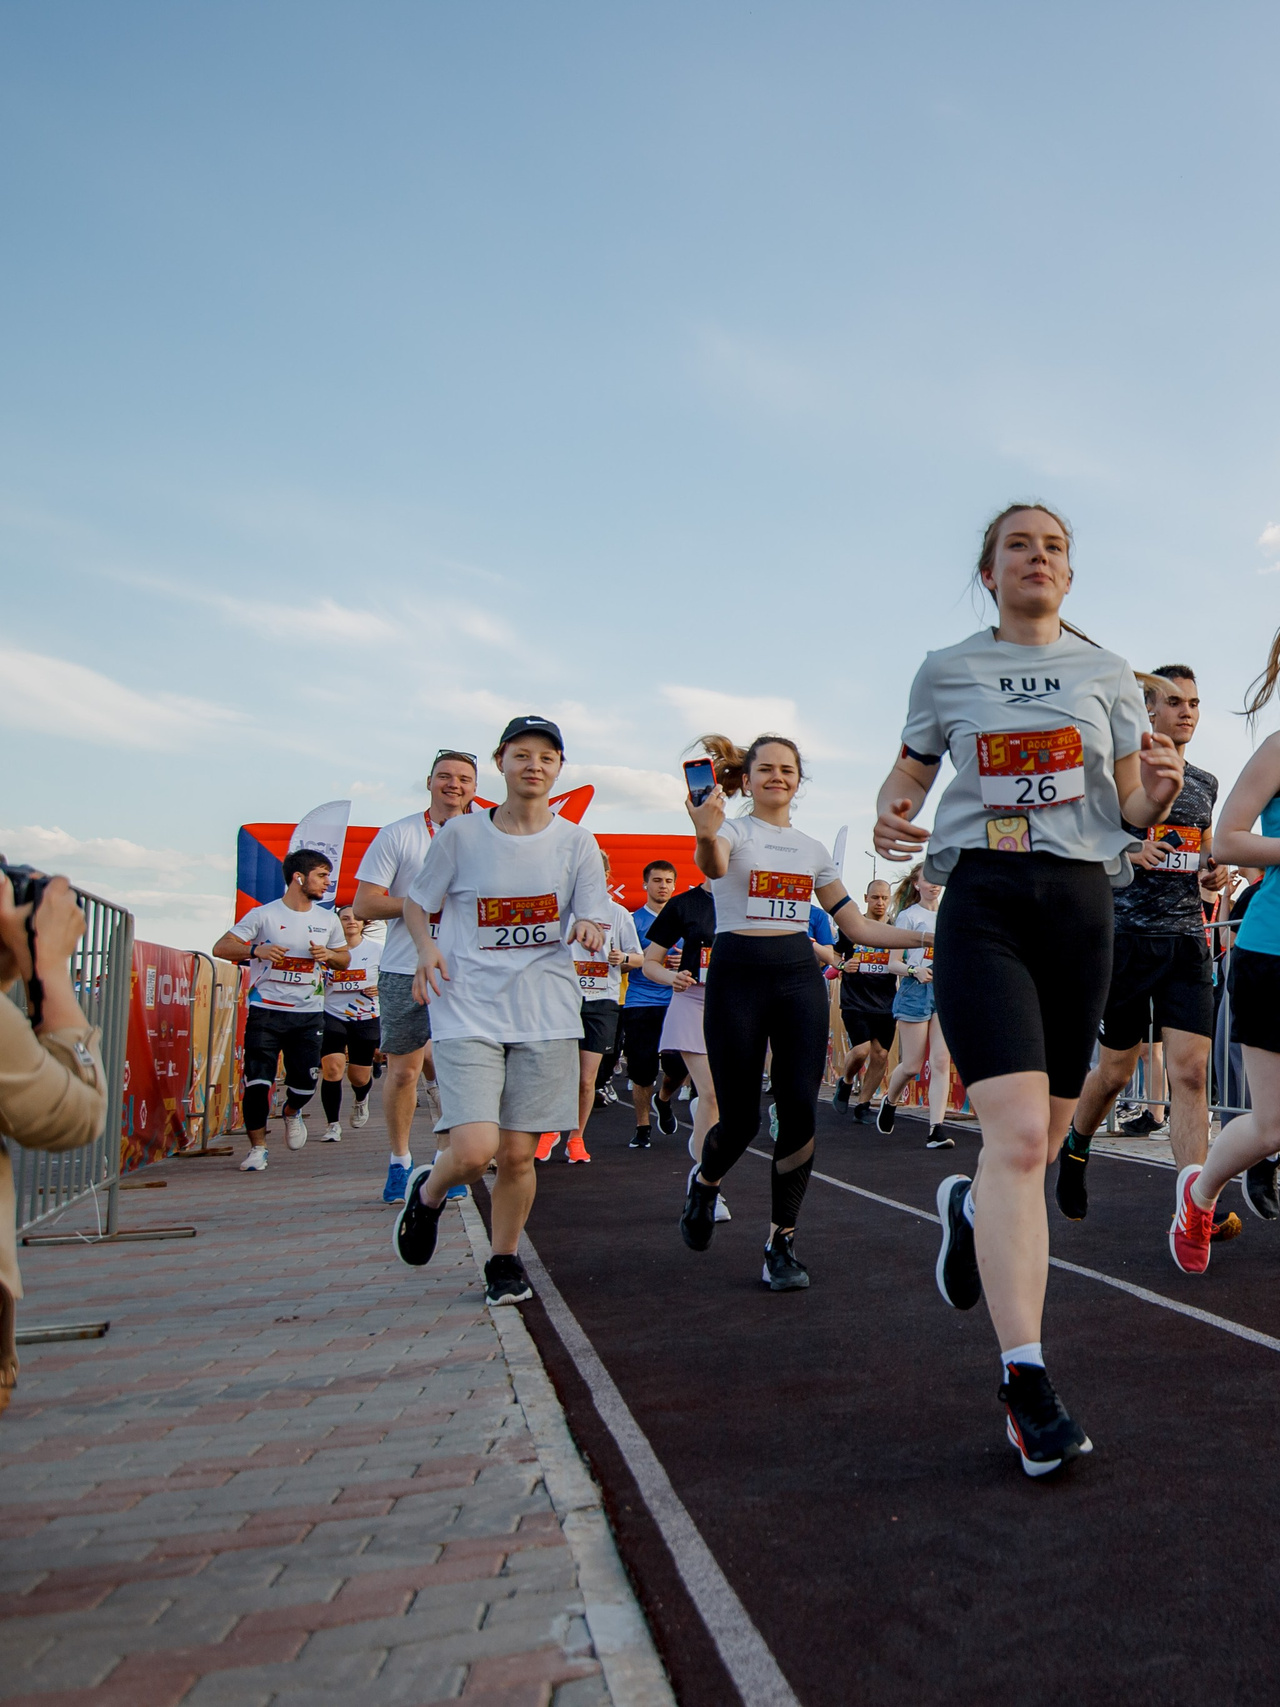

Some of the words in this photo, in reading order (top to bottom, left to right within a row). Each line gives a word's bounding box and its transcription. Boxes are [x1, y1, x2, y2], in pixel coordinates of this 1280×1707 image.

[1000, 678, 1061, 692] RUN
[1014, 775, 1057, 805] 26
[1166, 853, 1188, 870] 131
[768, 900, 797, 919] 113
[430, 924, 440, 936] 1
[495, 925, 547, 946] 206
[867, 963, 884, 973] 199
[282, 971, 302, 983] 115
[340, 981, 360, 991] 103
